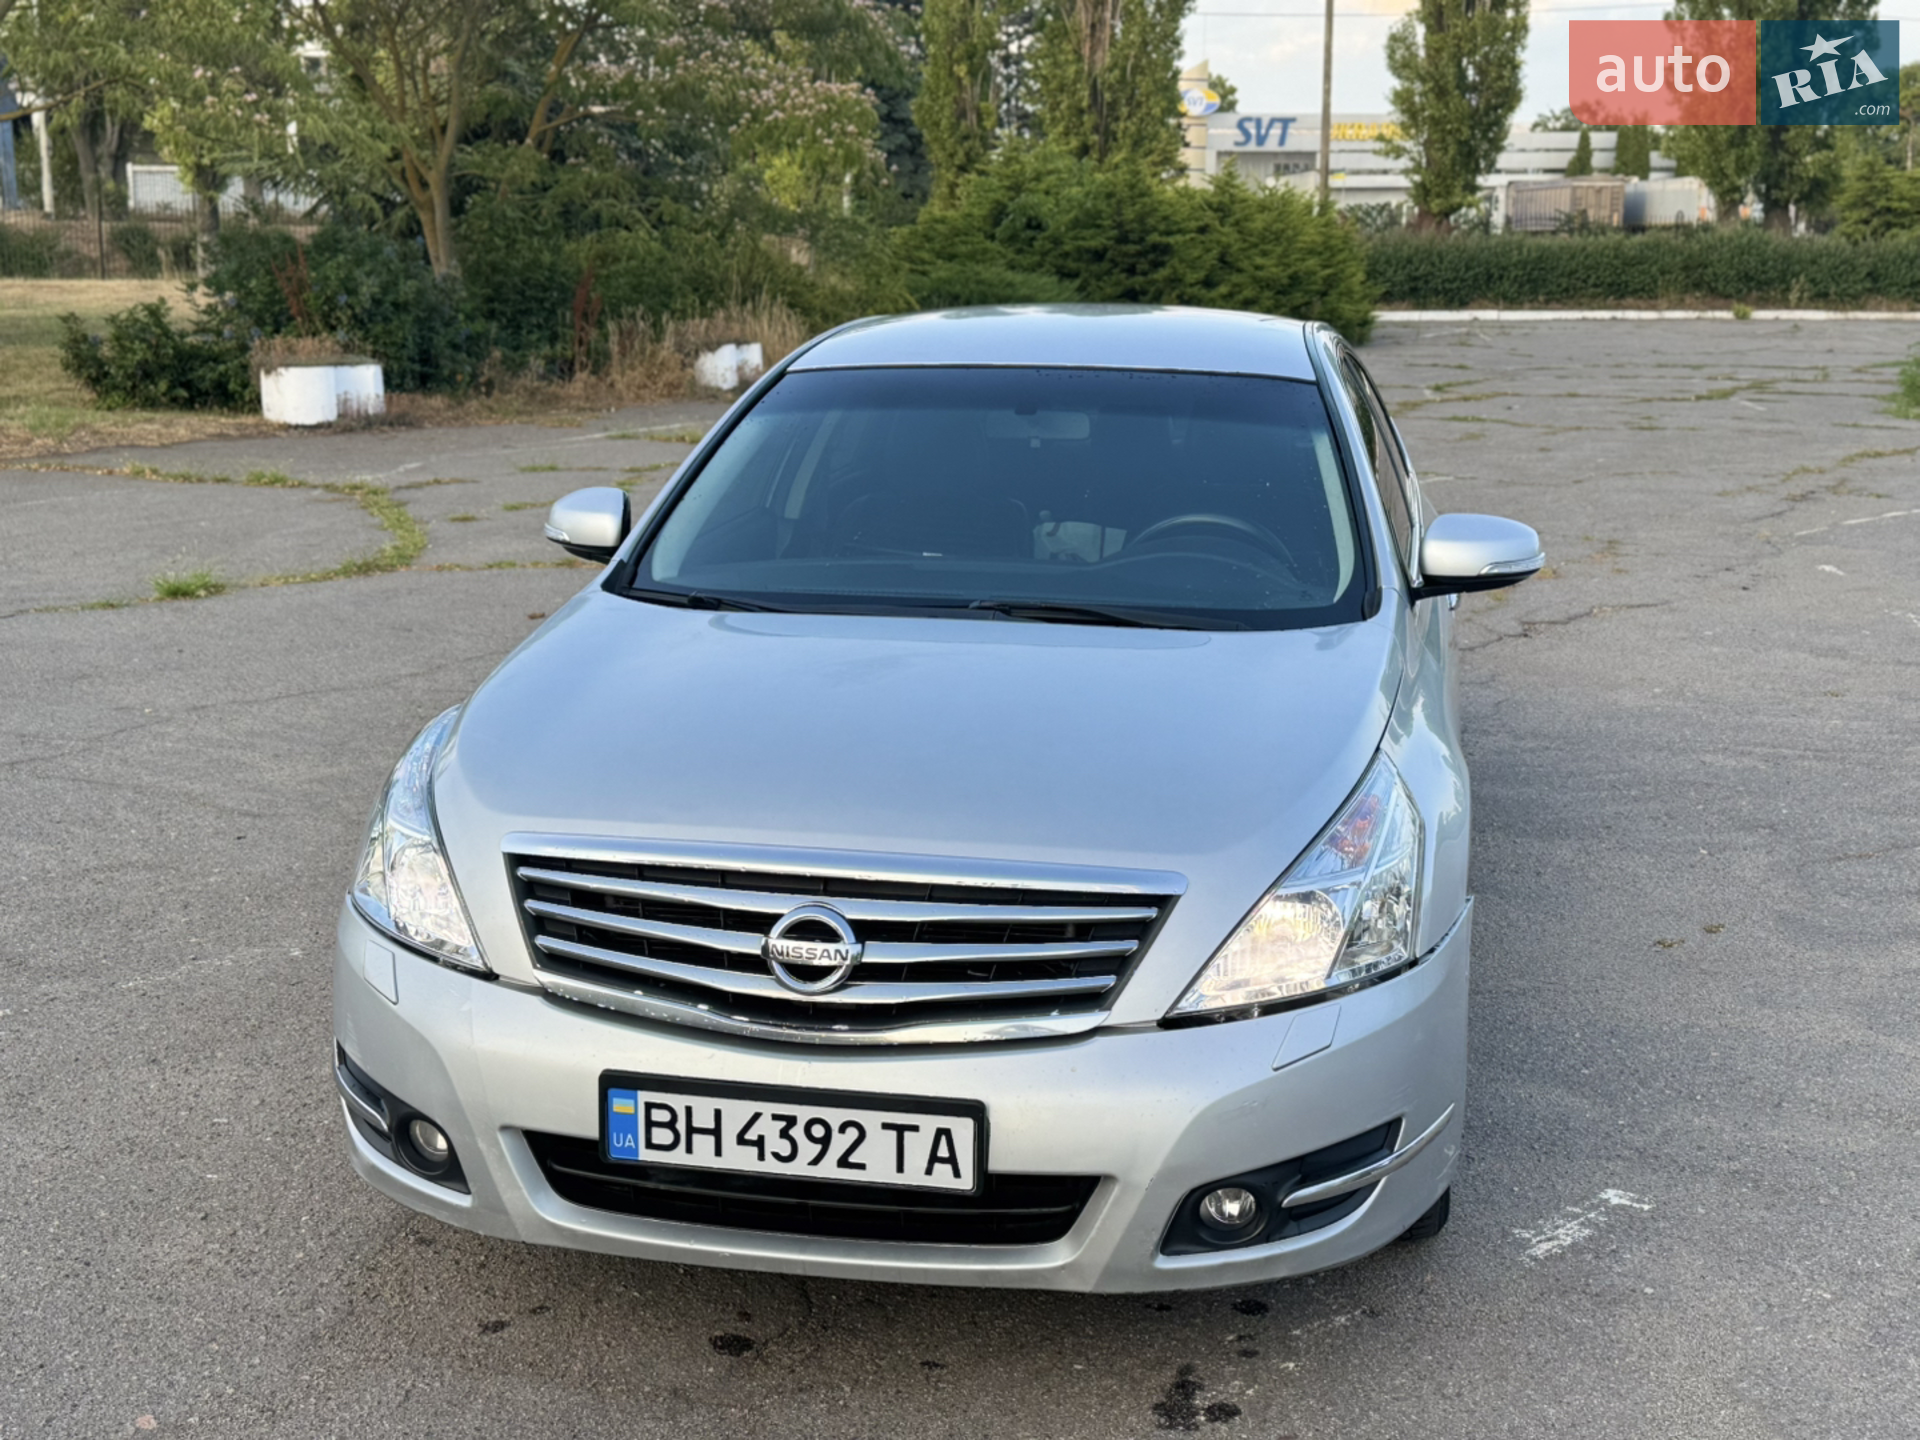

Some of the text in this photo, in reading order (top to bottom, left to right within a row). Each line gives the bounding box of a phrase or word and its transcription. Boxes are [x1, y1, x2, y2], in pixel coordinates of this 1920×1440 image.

[1233, 116, 1297, 147] SVT
[769, 943, 850, 962] NISSAN
[613, 1132, 636, 1149] UA
[643, 1101, 963, 1180] BH 4392 TA
